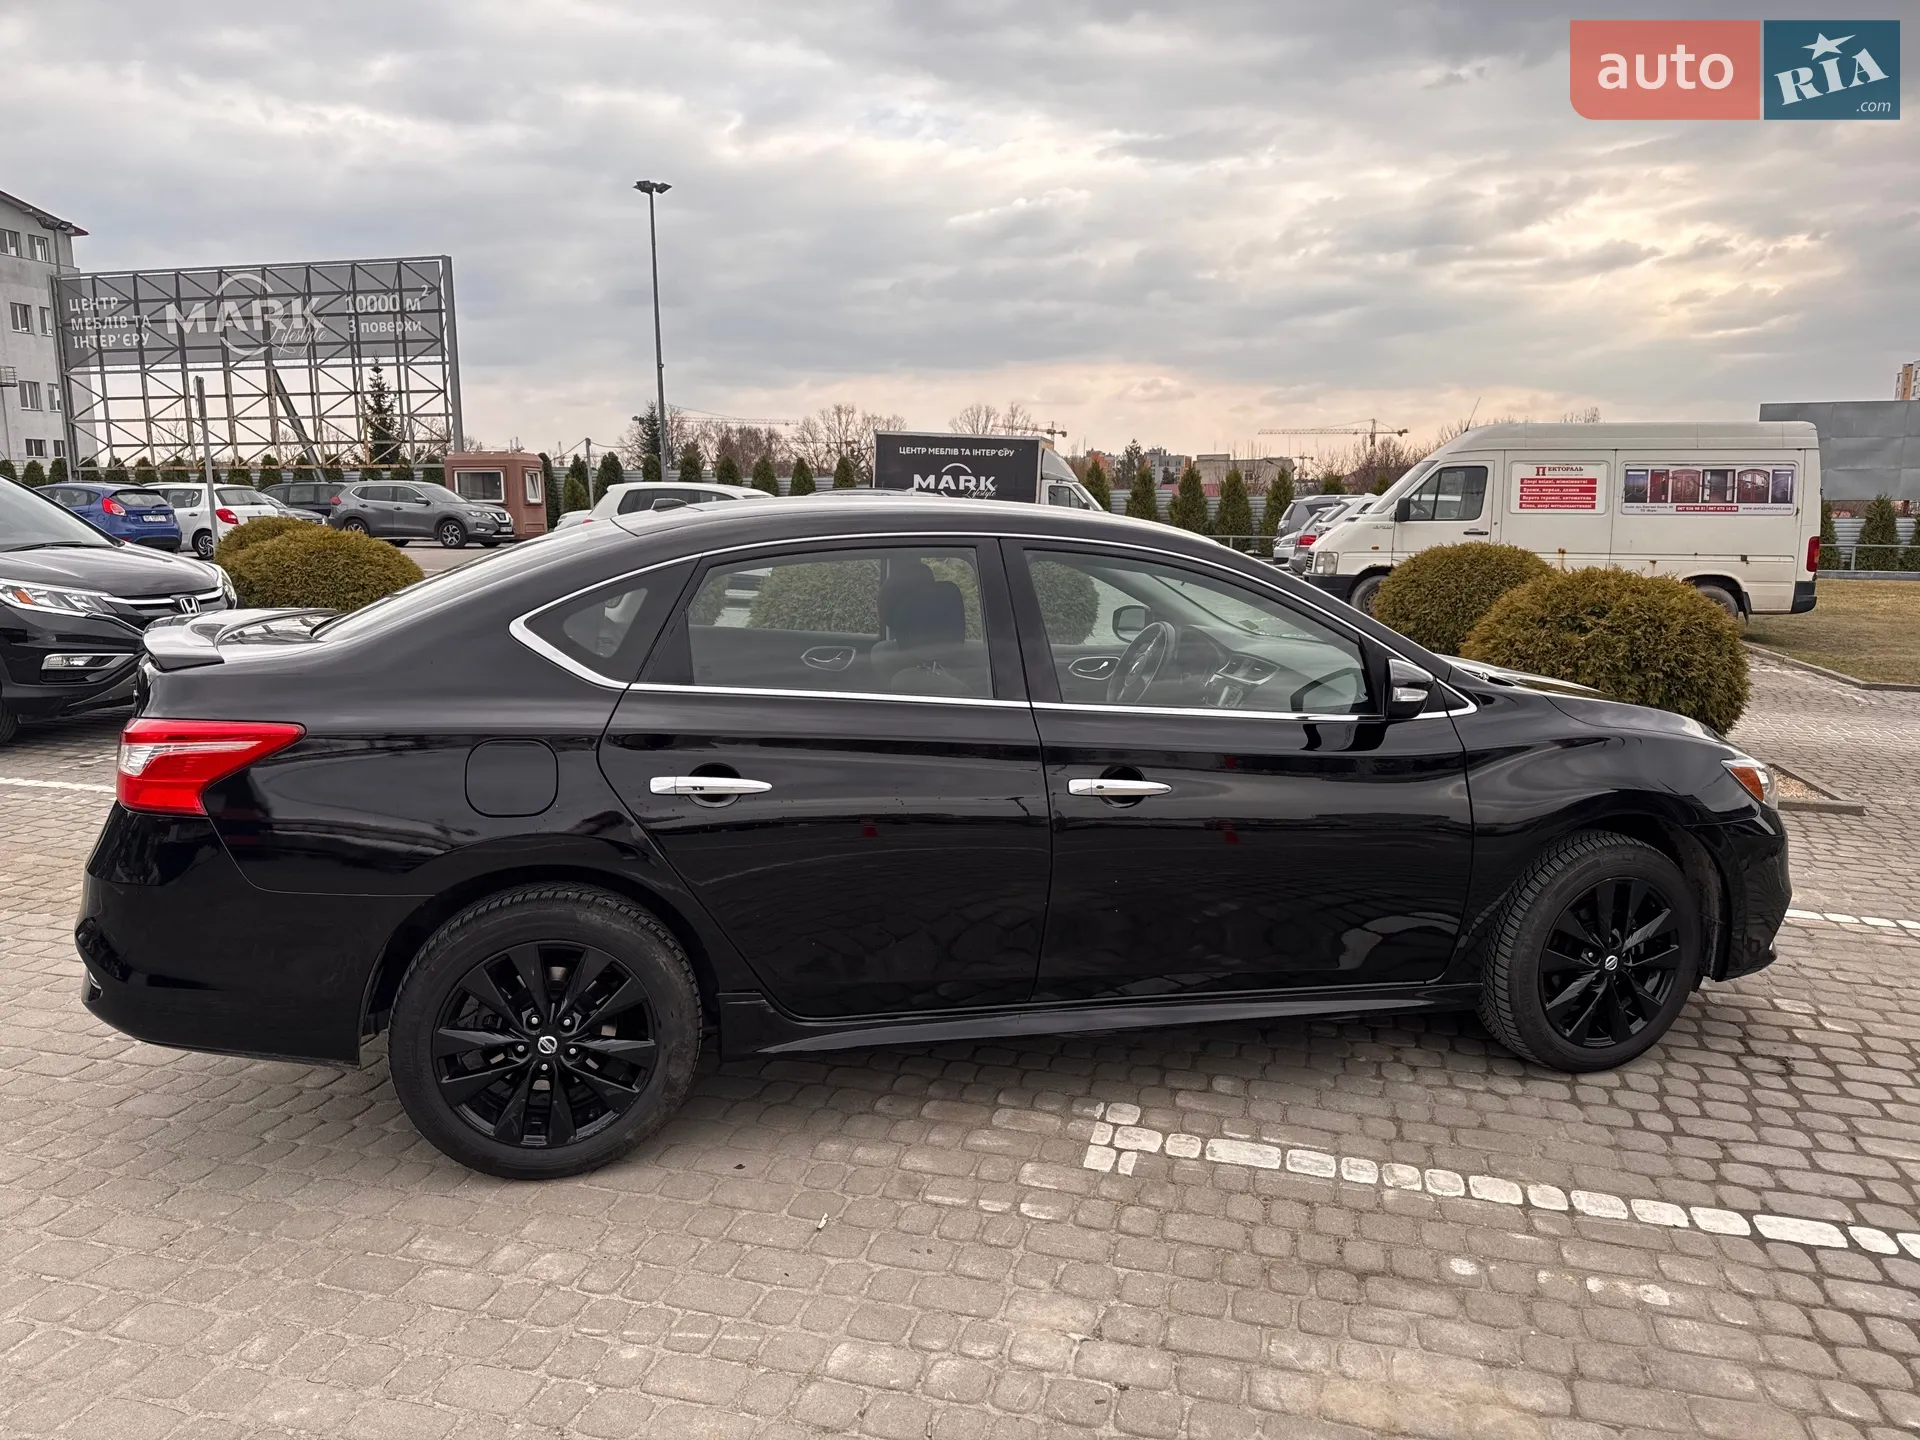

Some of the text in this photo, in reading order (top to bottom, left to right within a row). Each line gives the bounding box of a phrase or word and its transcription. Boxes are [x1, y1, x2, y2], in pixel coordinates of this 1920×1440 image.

[69, 297, 118, 314] ЦЕНТР
[345, 294, 400, 314] 10000
[71, 314, 152, 330] МЕБЛІВ ТА
[165, 298, 325, 334] MARK
[348, 320, 422, 336] 3 поверхи
[899, 446, 927, 456] ЦЕНТР
[928, 447, 959, 456] МЕБЛІВ
[960, 448, 971, 456] ТА
[1535, 466, 1584, 476] ПЕКТОРАЛЬ
[913, 474, 996, 491] MARK
